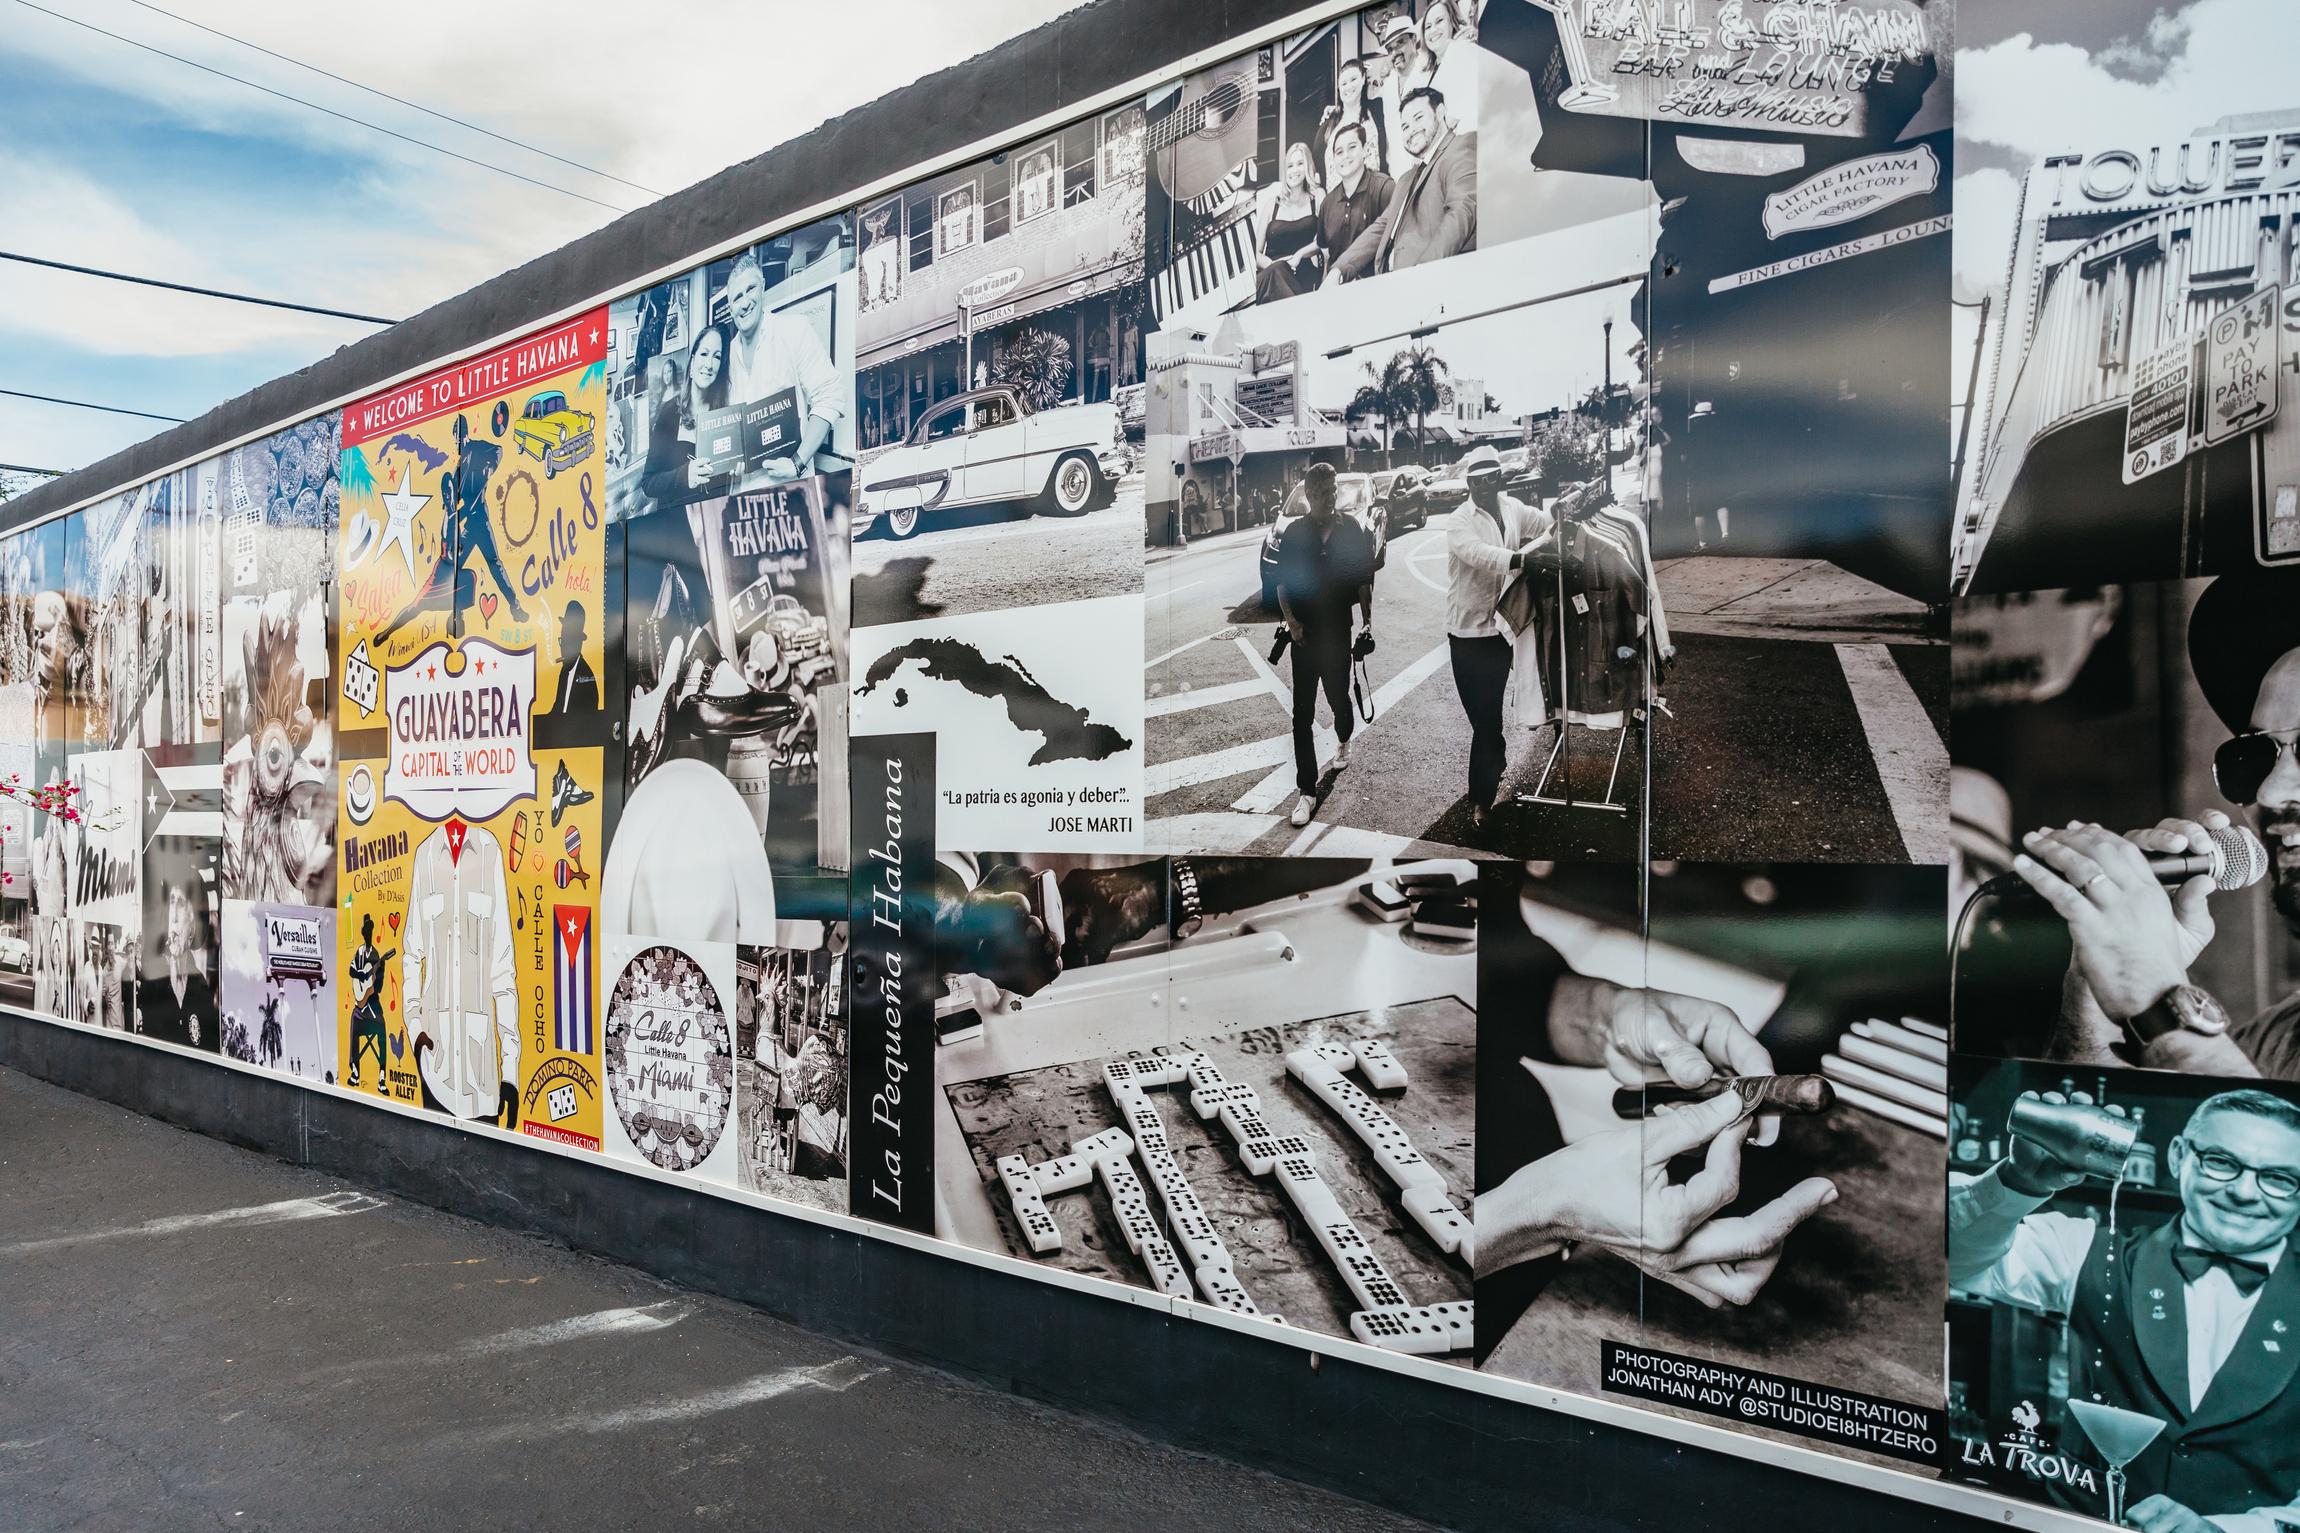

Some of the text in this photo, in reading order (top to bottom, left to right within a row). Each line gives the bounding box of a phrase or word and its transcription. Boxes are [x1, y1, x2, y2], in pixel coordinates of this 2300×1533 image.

[1775, 159, 1918, 213] LITTLE HAVANA
[1785, 175, 1911, 222] CIGAR FACTORY
[1738, 264, 1782, 285] FINE
[1787, 240, 1862, 270] CIGARS
[1883, 214, 1953, 245] LOUN
[2157, 353, 2187, 377] phone
[2158, 338, 2187, 364] payby
[2223, 337, 2260, 369] PAY
[363, 332, 579, 430] WELCOME TO LITTLE HAVANA
[2150, 368, 2186, 396] 40101
[2216, 365, 2267, 403] PARK
[2230, 358, 2252, 380] TO
[701, 417, 722, 432] LITTLE
[746, 408, 769, 425] LITTLE
[769, 398, 792, 415] HAVANA
[2130, 403, 2185, 439] paybyphone.com
[736, 492, 789, 520] LITTLE
[522, 471, 598, 597] Calle 8
[729, 515, 808, 557] HAVANA
[746, 590, 755, 611] 8
[515, 628, 521, 645] 8
[395, 684, 522, 743] GUAYABERA
[401, 748, 516, 778] CAPITAL OF THE WORLD
[965, 788, 1000, 808] patria
[1003, 791, 1018, 804] es
[1020, 788, 1063, 808] agonia
[1067, 791, 1075, 806] y
[1048, 816, 1132, 833] JOSE MARTI
[344, 830, 409, 874] Havana
[76, 846, 137, 908] Miami
[354, 864, 404, 893] Collection
[377, 890, 405, 905] By D'Asis
[271, 920, 317, 947] Versailles
[533, 885, 545, 1054] CALLE OCHO
[736, 962, 757, 975] OJITO
[868, 757, 908, 1213] La Pequeña Habana
[634, 1011, 692, 1048] Calle 8
[644, 1045, 687, 1061] Little Havana
[389, 1069, 418, 1088] ROOSTER
[395, 1086, 415, 1101] ALLEY
[526, 1060, 594, 1107] DOMINO PARK
[639, 1060, 695, 1100] Miami
[524, 1123, 599, 1151] #THEHAVANACOLLECTION
[1614, 1348, 1928, 1432] PHOTOGRAPHY AND ILLUSTRATION
[1608, 1368, 1937, 1455] JONATHAN ADY @STUDIOEI8HTZERO
[2008, 1433, 2046, 1448] CAFE
[1961, 1438, 2099, 1495] LA TROVA
